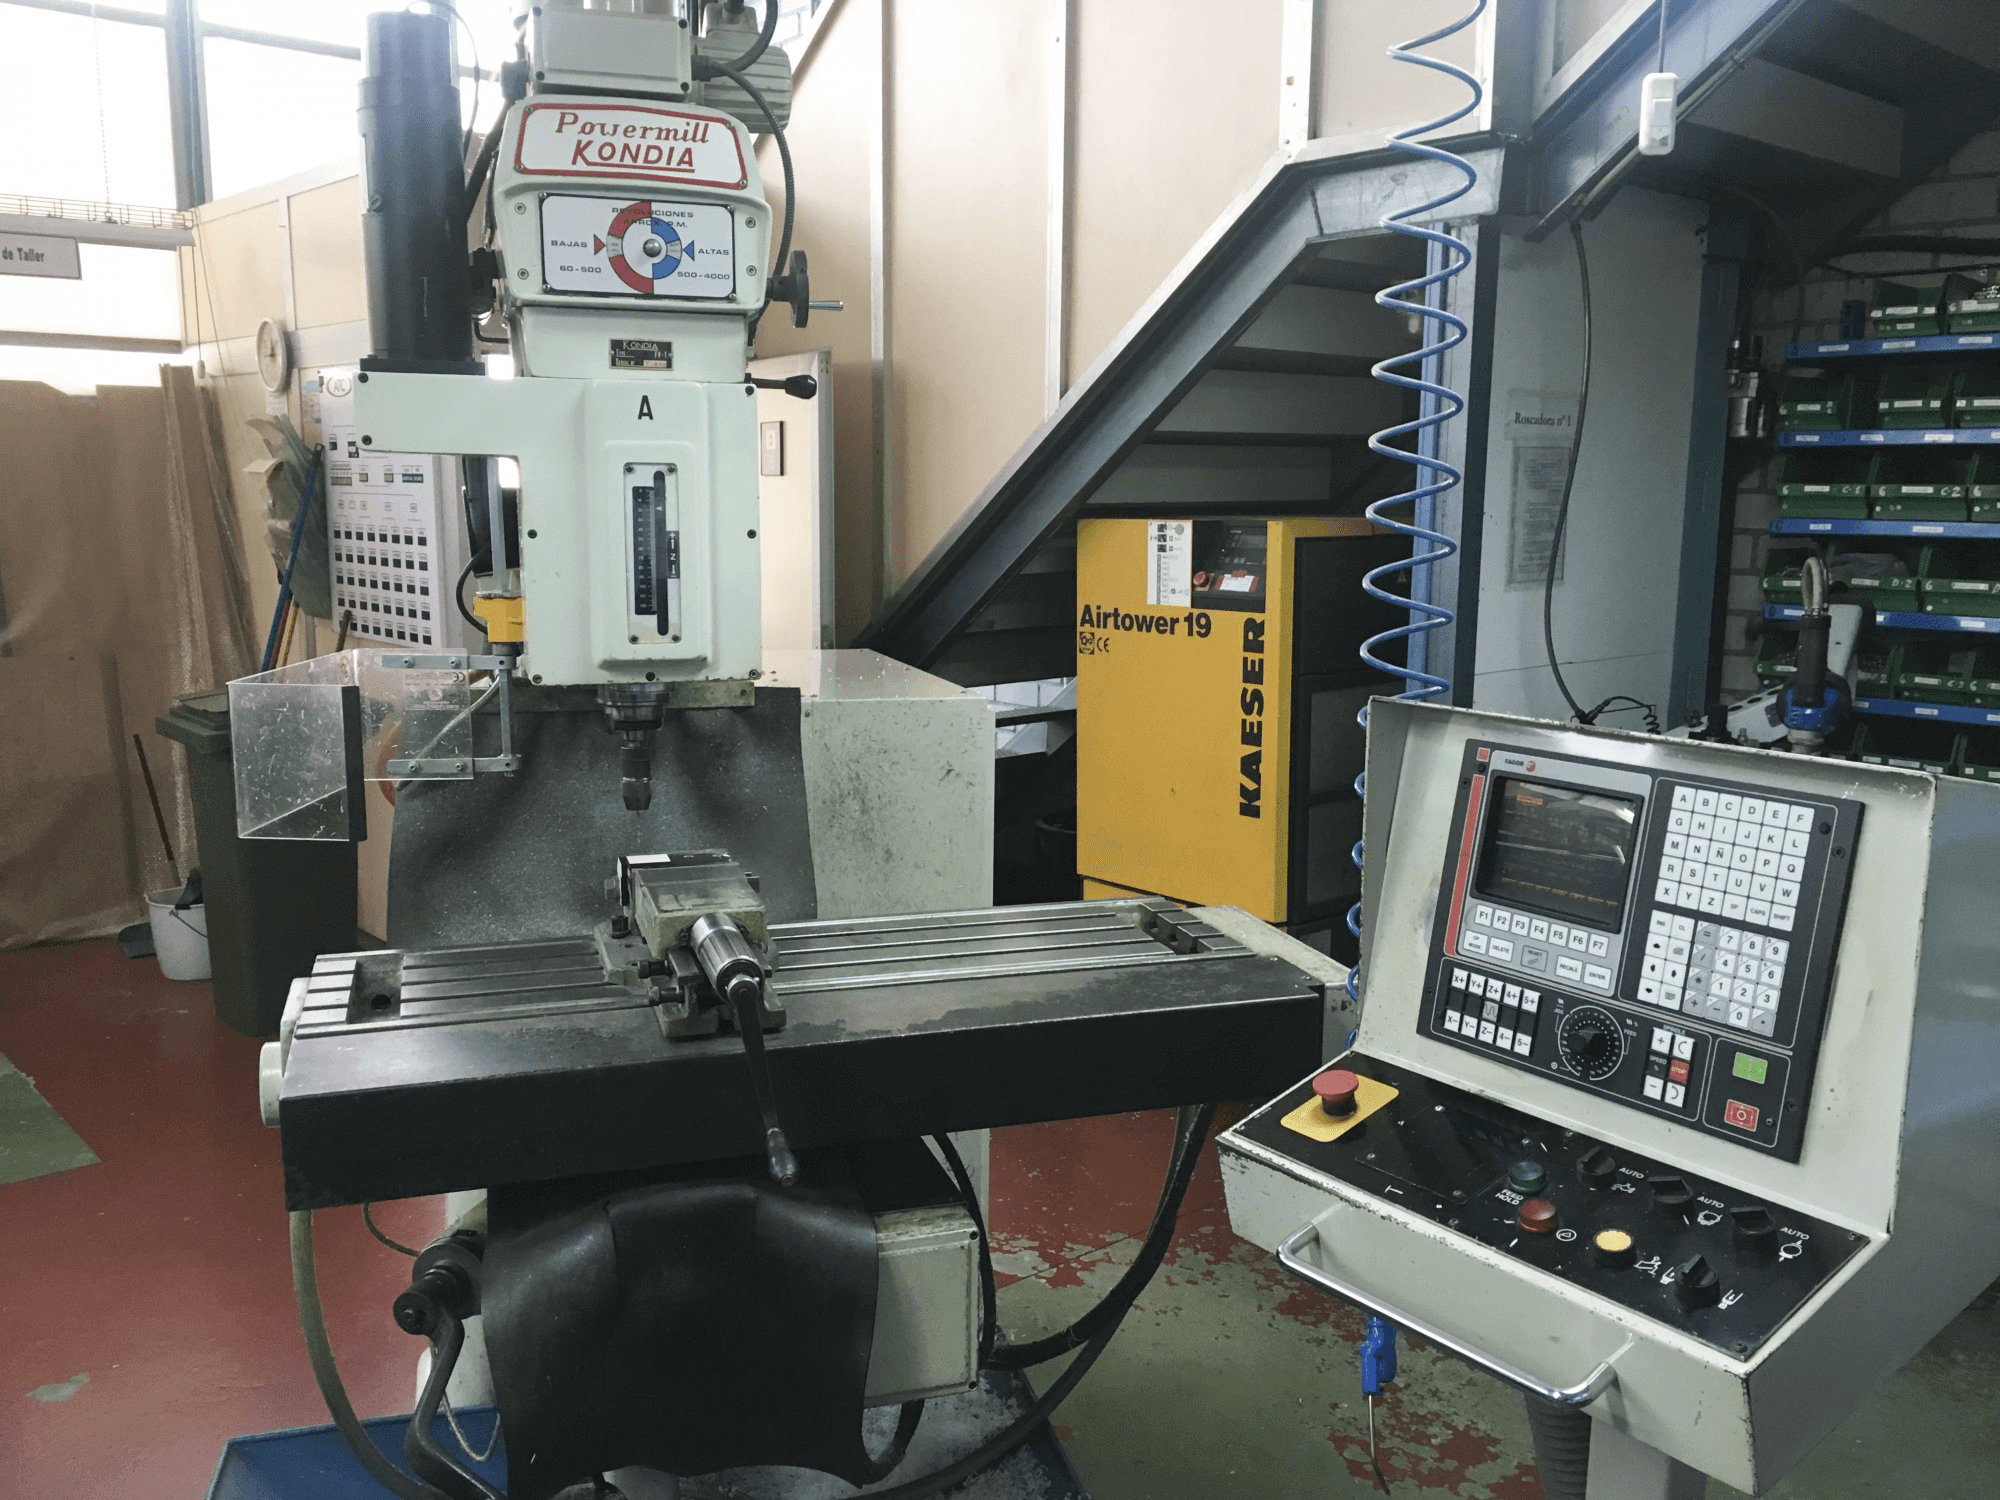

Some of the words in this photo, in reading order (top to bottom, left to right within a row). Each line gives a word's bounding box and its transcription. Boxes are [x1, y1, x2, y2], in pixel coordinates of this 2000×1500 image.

[555, 112, 709, 143] Powermill
[571, 139, 695, 172] KONDIA
[611, 207, 694, 218] REVOLUCIONES
[551, 240, 588, 248] BAJAS
[698, 247, 730, 256] ALTAS
[2, 246, 14, 260] de
[16, 247, 45, 262] Taller
[623, 340, 659, 352] KONDIA
[638, 395, 654, 420] A
[1080, 604, 1180, 635] Airtower
[1183, 612, 1212, 638] 19
[1096, 636, 1110, 653] CE
[1239, 617, 1265, 819] KAESER
[1504, 758, 1524, 767] FAGOR
[1680, 794, 1687, 803] A
[1702, 798, 1709, 807] B
[1725, 802, 1733, 811] C
[1748, 806, 1756, 815] D
[1772, 810, 1780, 819] E
[1796, 814, 1804, 823] F
[1675, 817, 1683, 826] G
[1698, 821, 1705, 830] H
[1744, 830, 1751, 839] J
[1767, 834, 1775, 843] K
[1792, 839, 1798, 848] L
[1670, 841, 1679, 850] M
[1694, 845, 1701, 854] N
[1739, 854, 1747, 863] O
[1763, 859, 1771, 867] P
[1787, 864, 1795, 873] Q
[1667, 864, 1675, 873] R
[1689, 868, 1696, 877] S
[1713, 873, 1719, 882] T
[1735, 878, 1743, 887] U
[1759, 883, 1766, 892] V
[1782, 888, 1792, 897] W
[1663, 887, 1670, 896] X
[1686, 892, 1692, 900] Y
[1708, 897, 1715, 906] Z
[1750, 908, 1766, 916] CAPS
[1479, 910, 1488, 920] F1
[1497, 915, 1507, 925] F2
[1515, 920, 1525, 930] F3
[1534, 925, 1544, 935] F4
[1553, 930, 1563, 940] F5
[1573, 935, 1583, 945] F6
[1593, 940, 1604, 950] F7
[1727, 935, 1733, 944] 7
[1749, 941, 1755, 950] 8
[1772, 946, 1779, 955] 9
[1722, 959, 1728, 967] 4
[1745, 964, 1751, 973] 5
[1768, 970, 1774, 979] 6
[1454, 974, 1465, 983] X+
[1471, 980, 1482, 989] Y+
[1488, 985, 1499, 994] Z+
[1506, 991, 1517, 1000] 4+
[1524, 996, 1536, 1006] 5+
[1741, 988, 1747, 997] 2
[1763, 994, 1771, 1003] 3
[1736, 1011, 1743, 1020] 0
[1623, 1028, 1637, 1037] FEED
[1618, 1167, 1645, 1179] AUTO
[1494, 1192, 1520, 1205] HOLD
[1501, 1188, 1524, 1200] FEED
[1697, 1195, 1725, 1209] AUTO
[1779, 1226, 1810, 1240] AUTO
